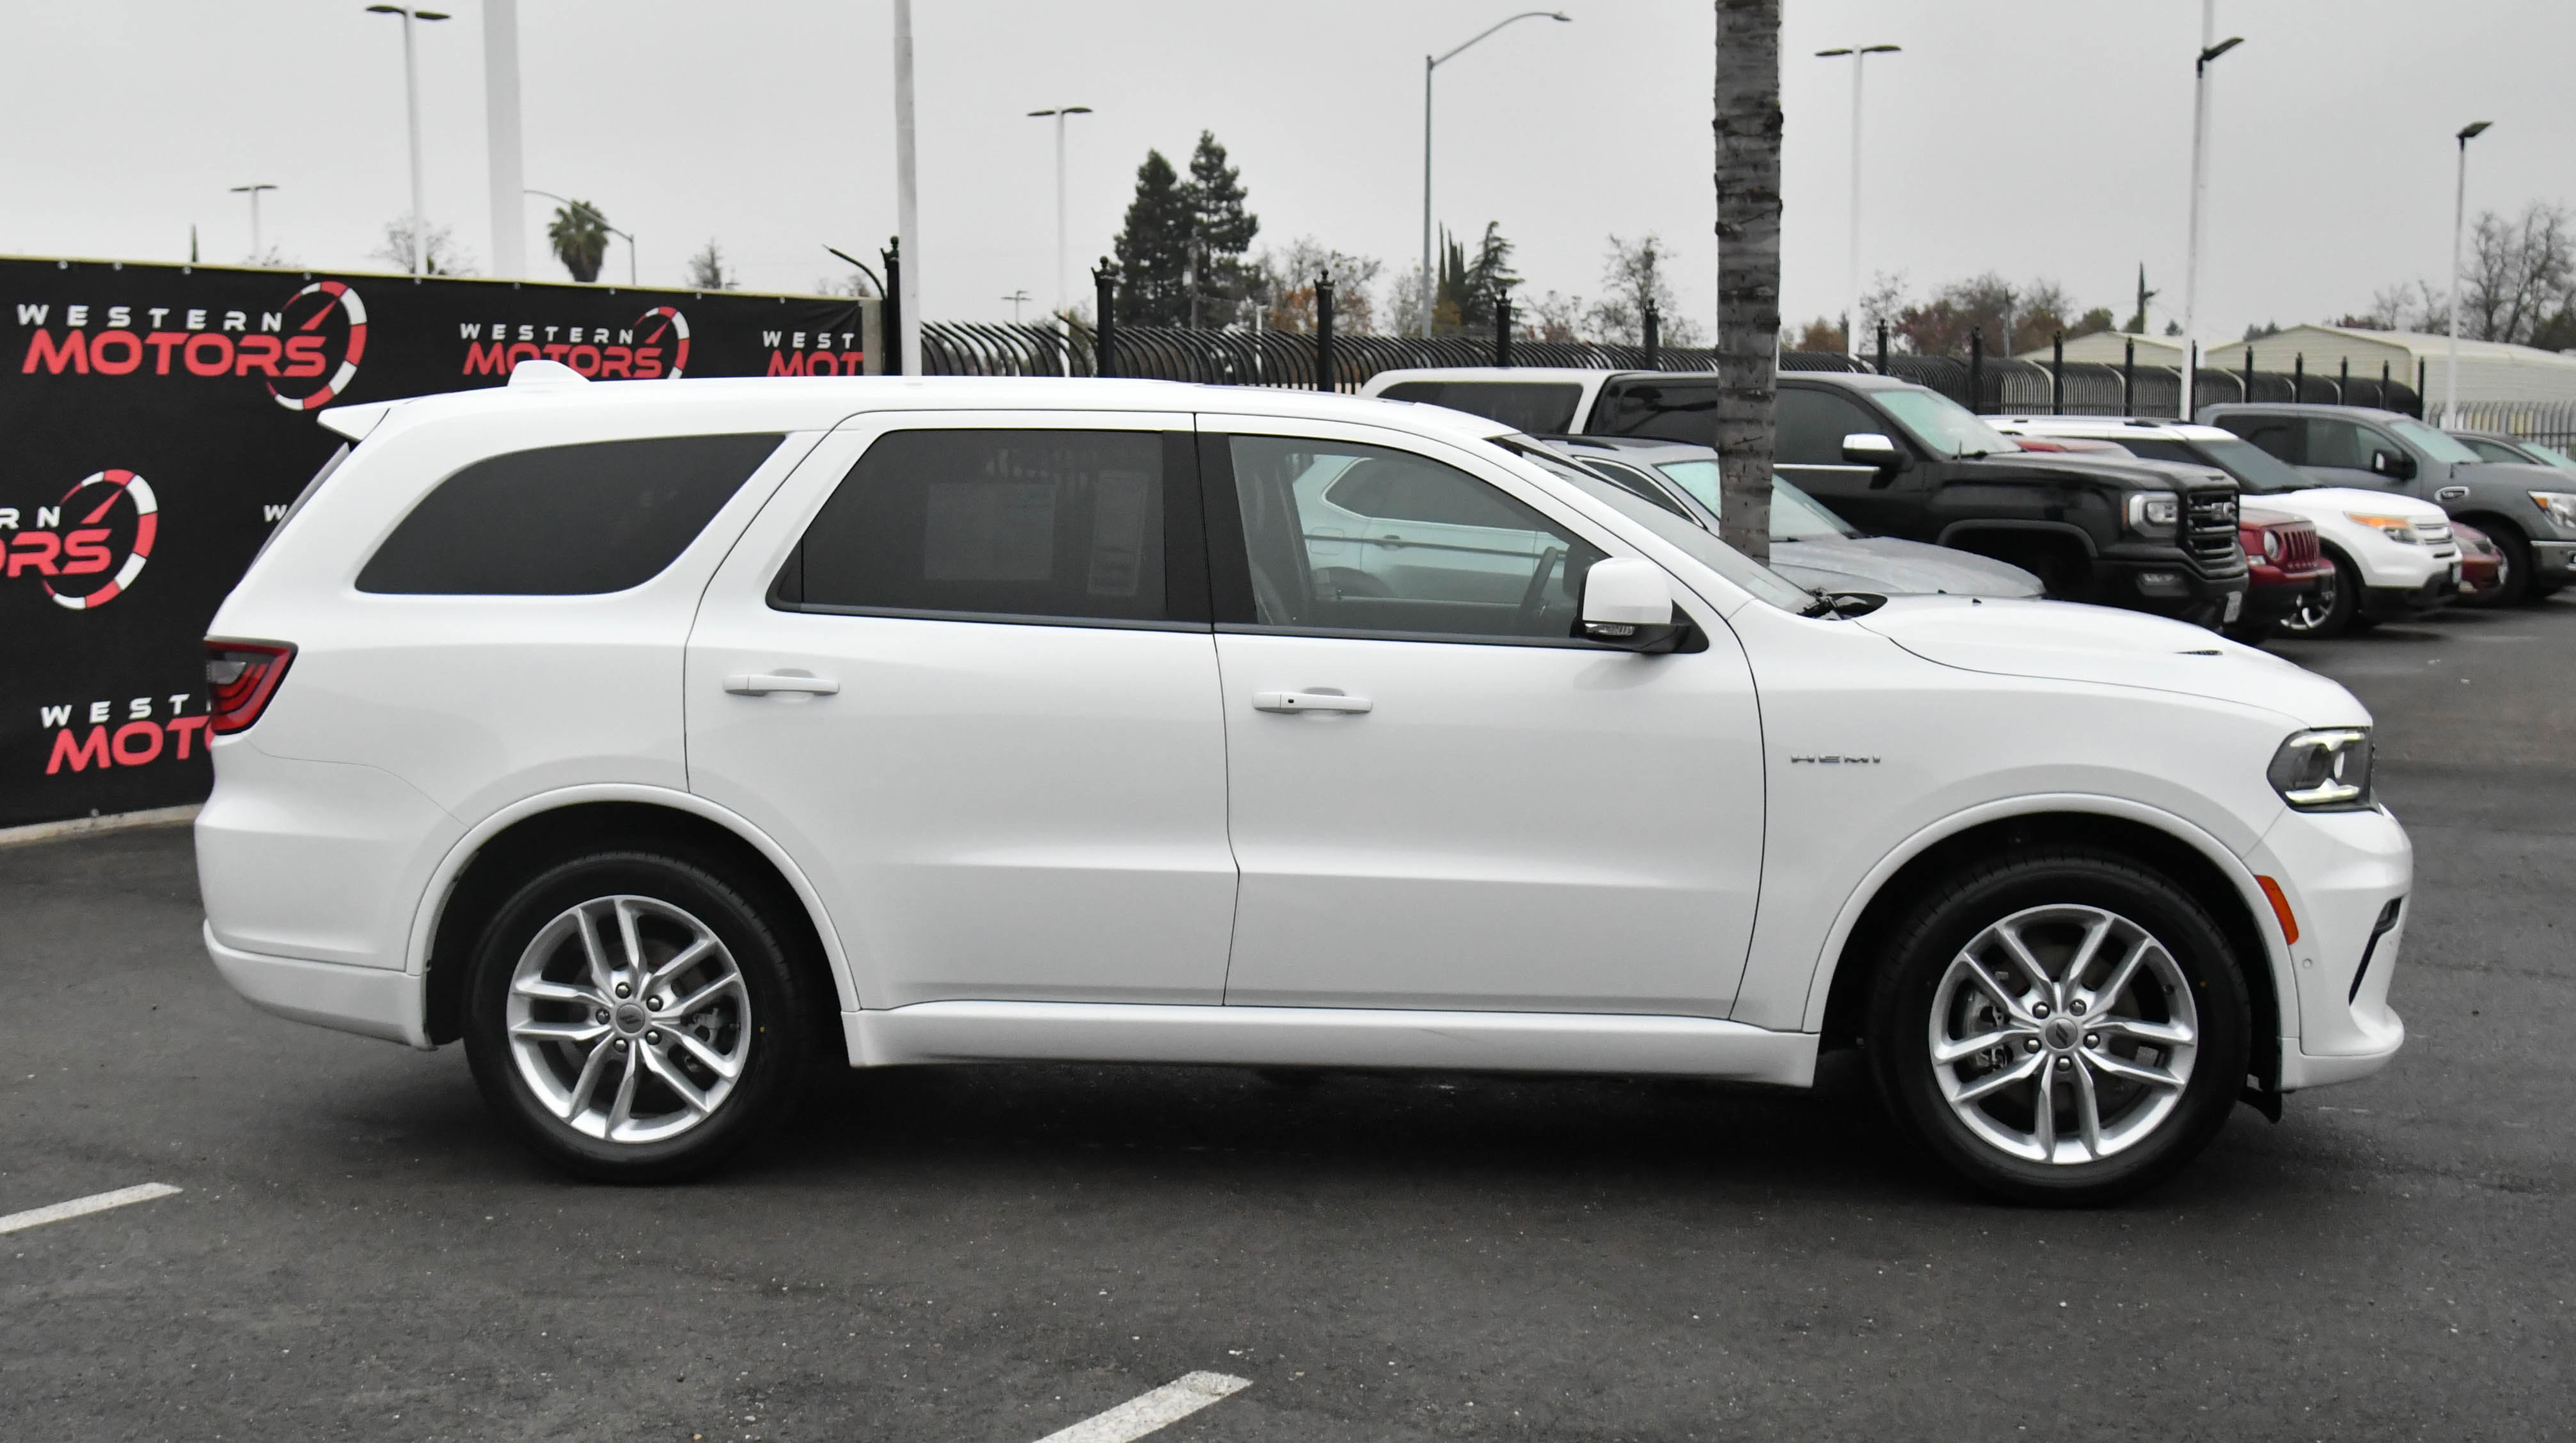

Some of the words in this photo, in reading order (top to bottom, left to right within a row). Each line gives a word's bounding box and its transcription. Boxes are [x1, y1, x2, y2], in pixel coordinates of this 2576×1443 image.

[17, 304, 282, 331] WESTERN
[460, 322, 633, 345] WESTERN
[22, 329, 326, 377] MOTORS
[0, 528, 112, 578] RS
[40, 694, 212, 728] WEST
[45, 714, 215, 775] MOT
[1790, 753, 1880, 764] HEMI
